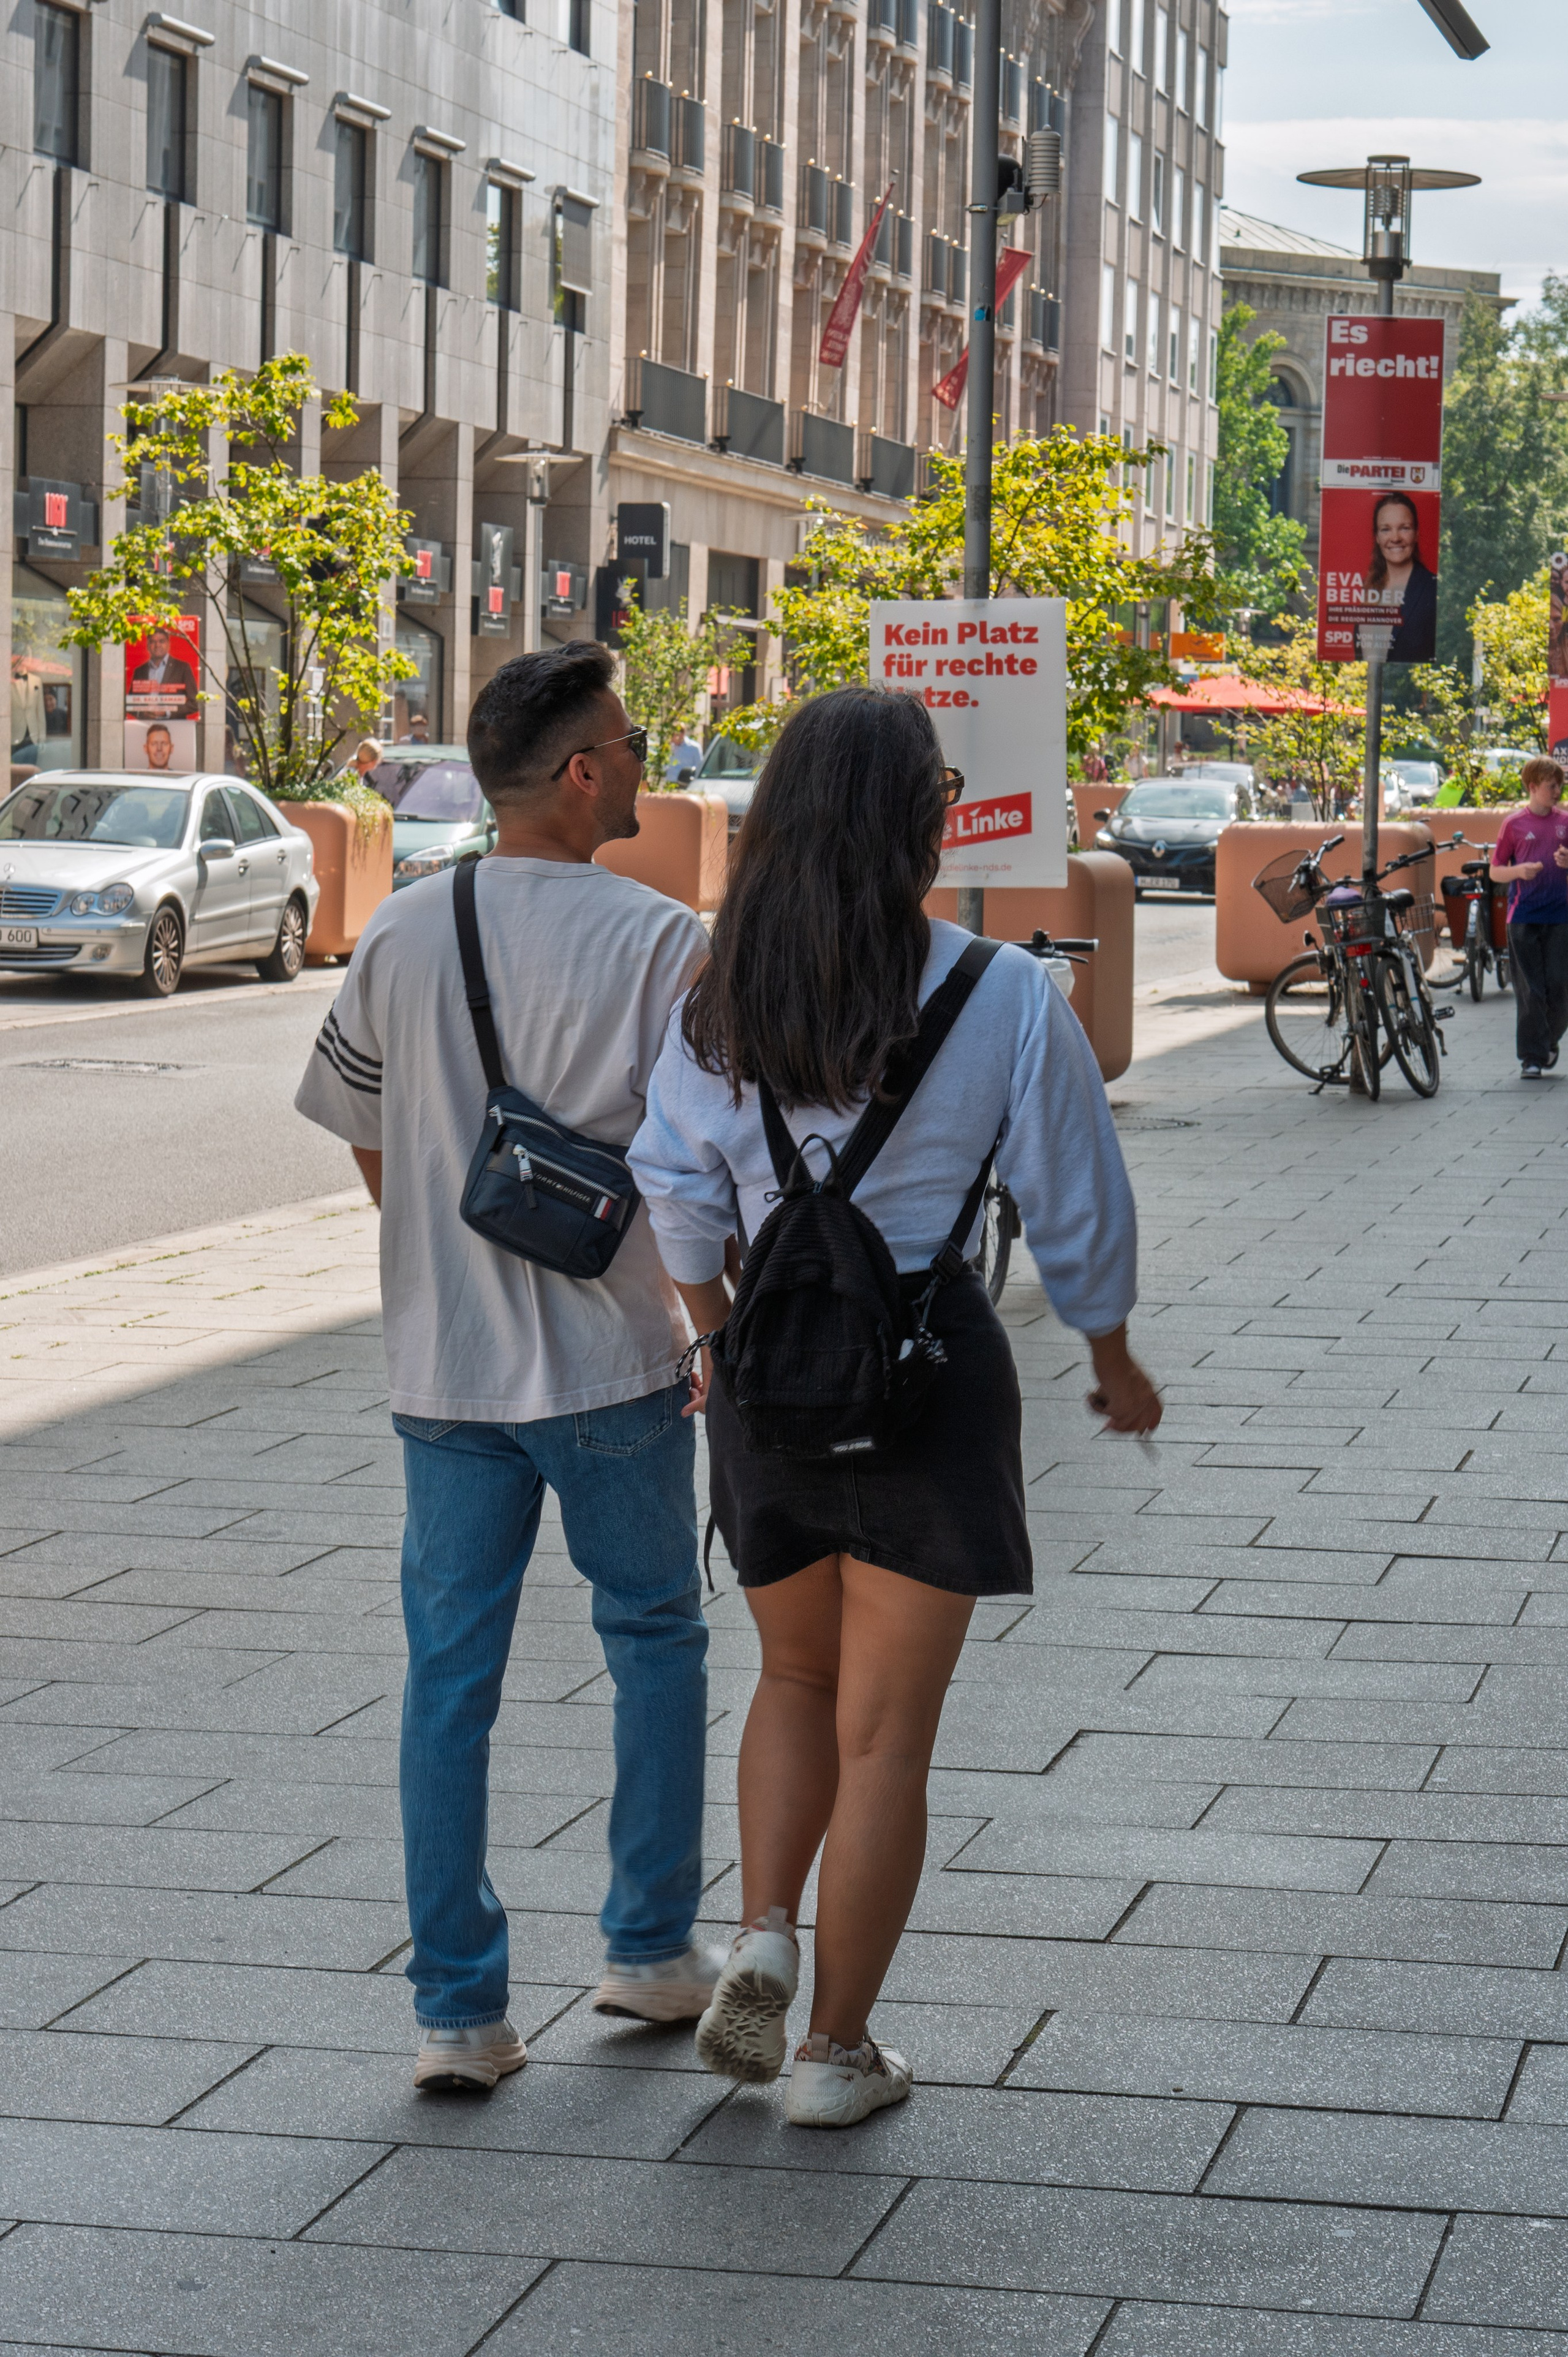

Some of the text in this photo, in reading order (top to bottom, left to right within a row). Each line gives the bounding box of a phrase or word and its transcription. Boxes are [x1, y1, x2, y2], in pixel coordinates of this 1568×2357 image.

[1331, 319, 1368, 344] Es
[1330, 353, 1439, 379] riecht!
[1337, 464, 1406, 479] Die PARTEI
[624, 535, 657, 545] HOTEL
[1326, 572, 1363, 587] EVA
[1326, 588, 1405, 605] BENDER
[884, 621, 1039, 646] Kein Platz
[1324, 630, 1353, 643] SPD
[883, 652, 1038, 677] für rechte
[885, 686, 979, 708] tze.
[957, 806, 1023, 838] Linke
[7, 929, 31, 942] 600
